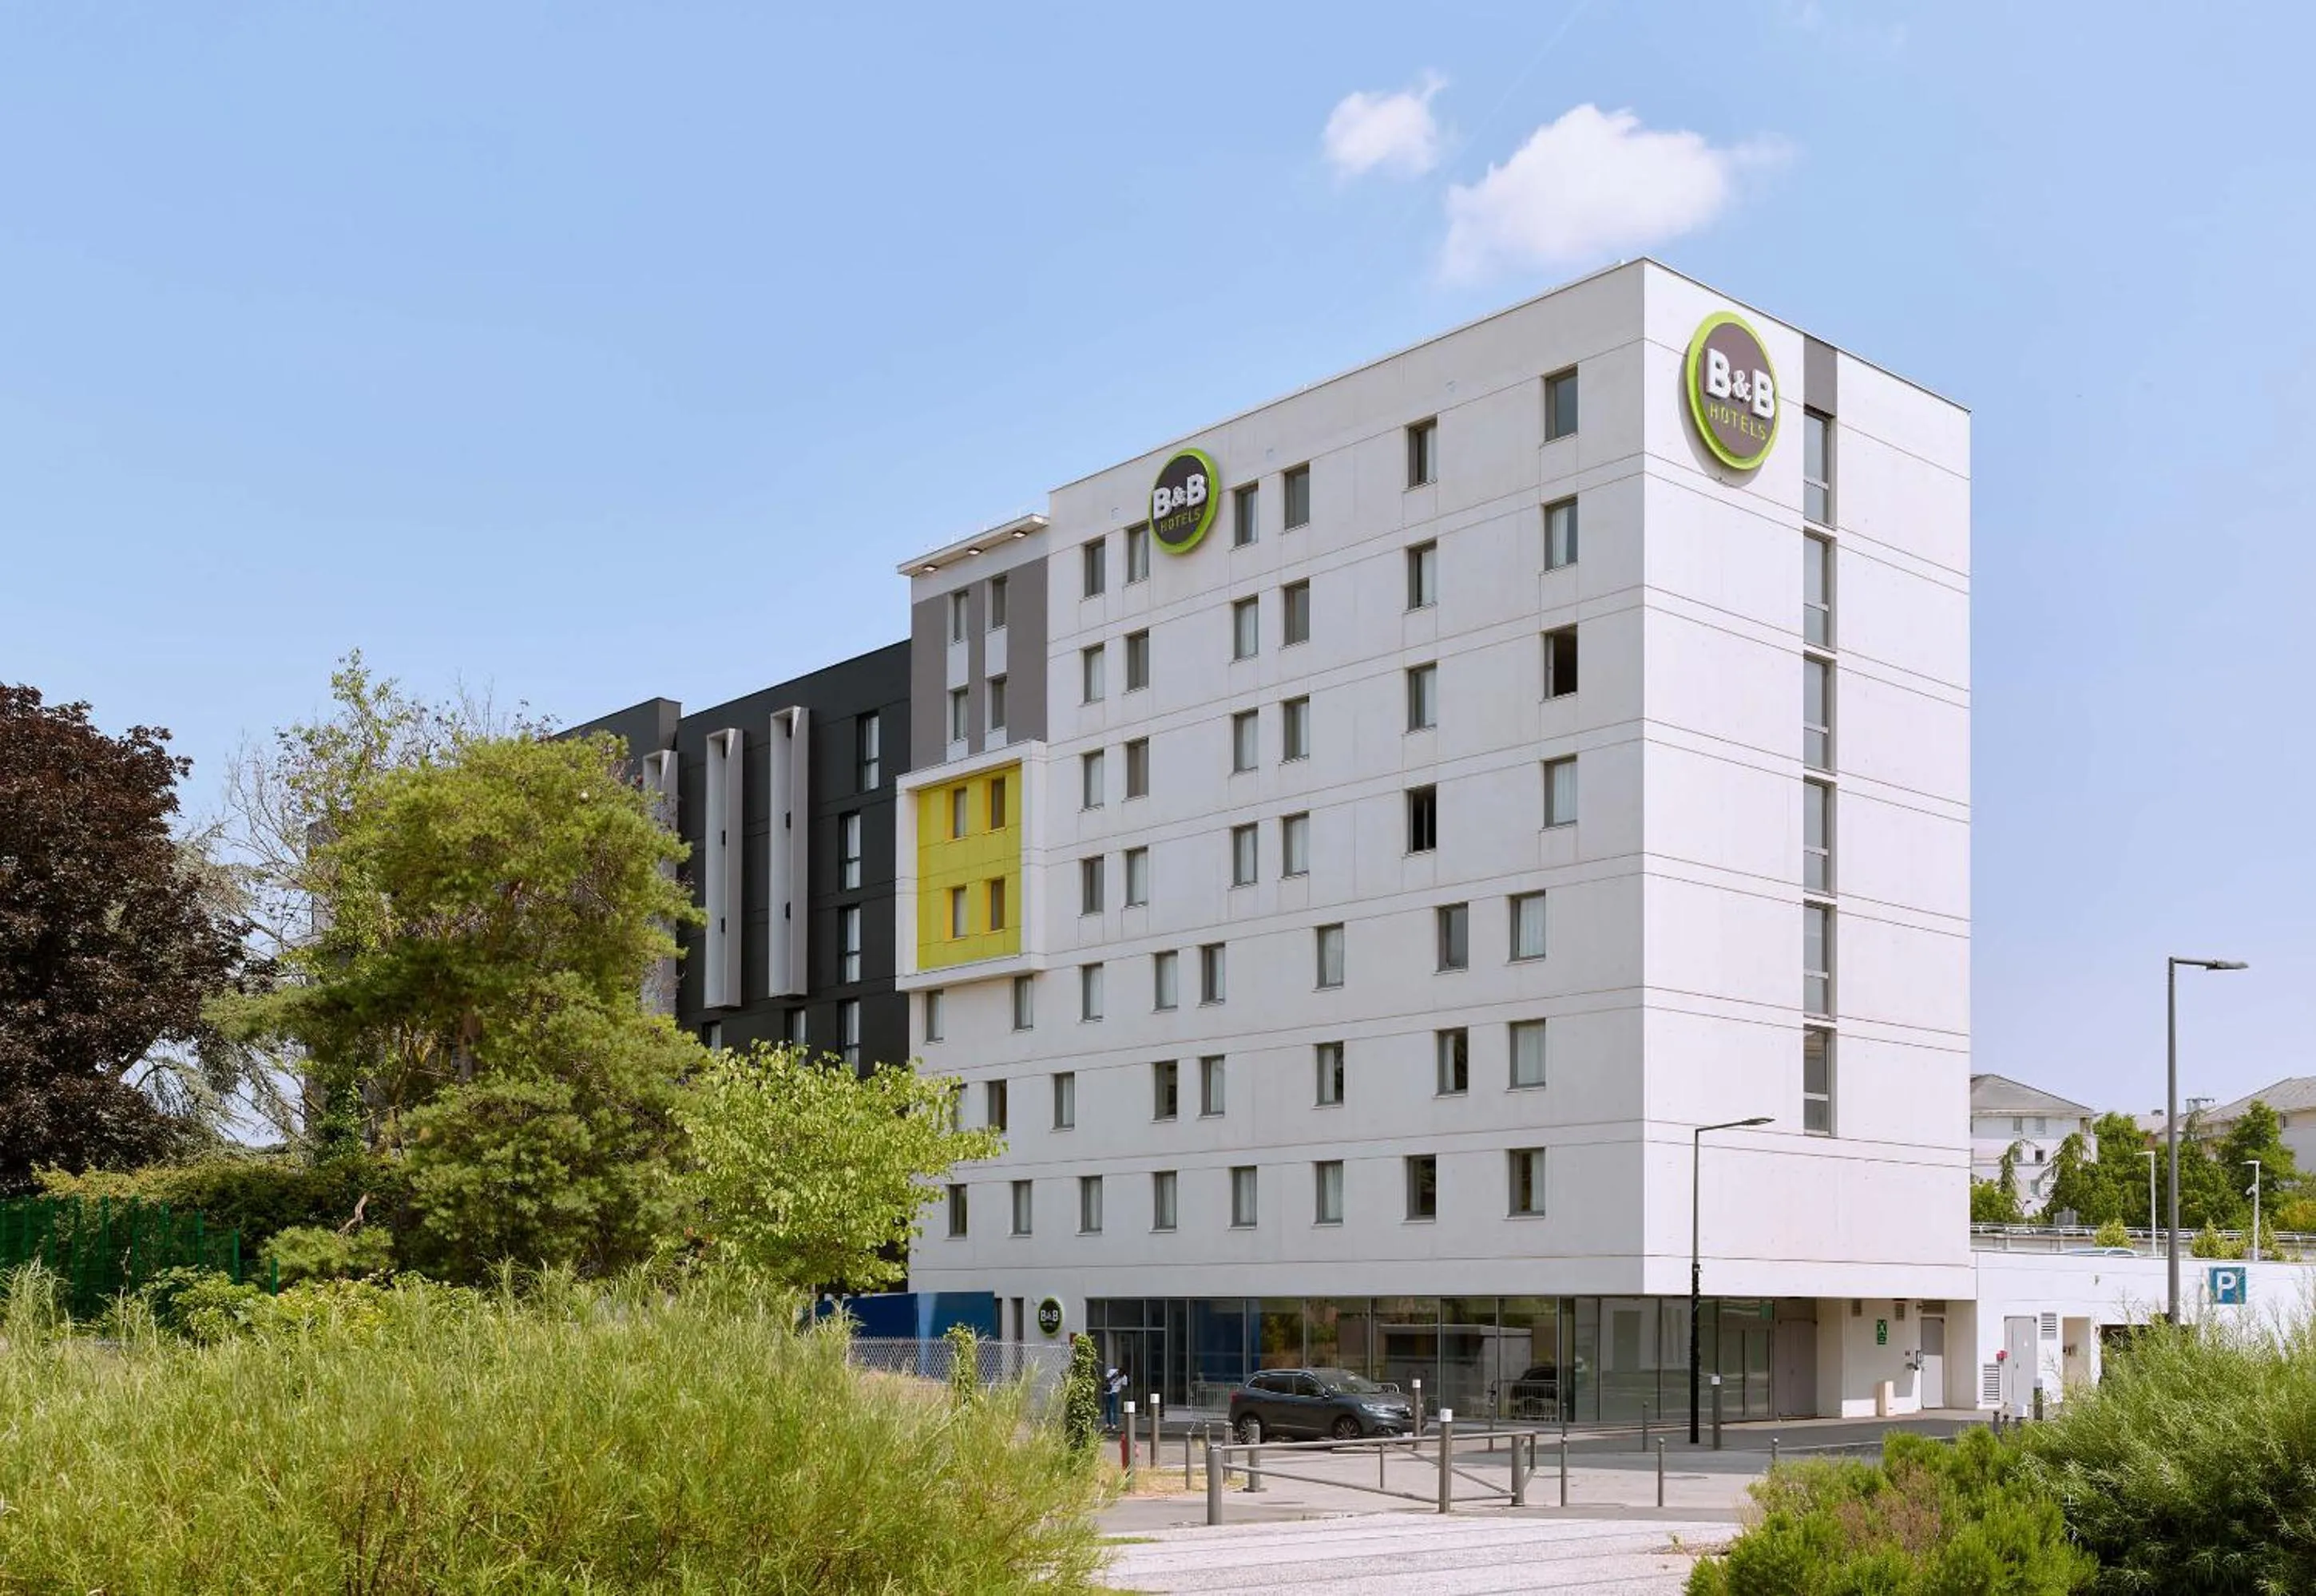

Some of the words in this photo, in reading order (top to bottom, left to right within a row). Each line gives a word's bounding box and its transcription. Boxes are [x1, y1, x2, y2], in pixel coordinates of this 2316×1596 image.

[1706, 348, 1775, 418] B&B
[1710, 403, 1766, 439] HOTELS
[1152, 473, 1207, 520] B&B
[1160, 509, 1200, 533] HOTELS
[2217, 1271, 2236, 1301] P
